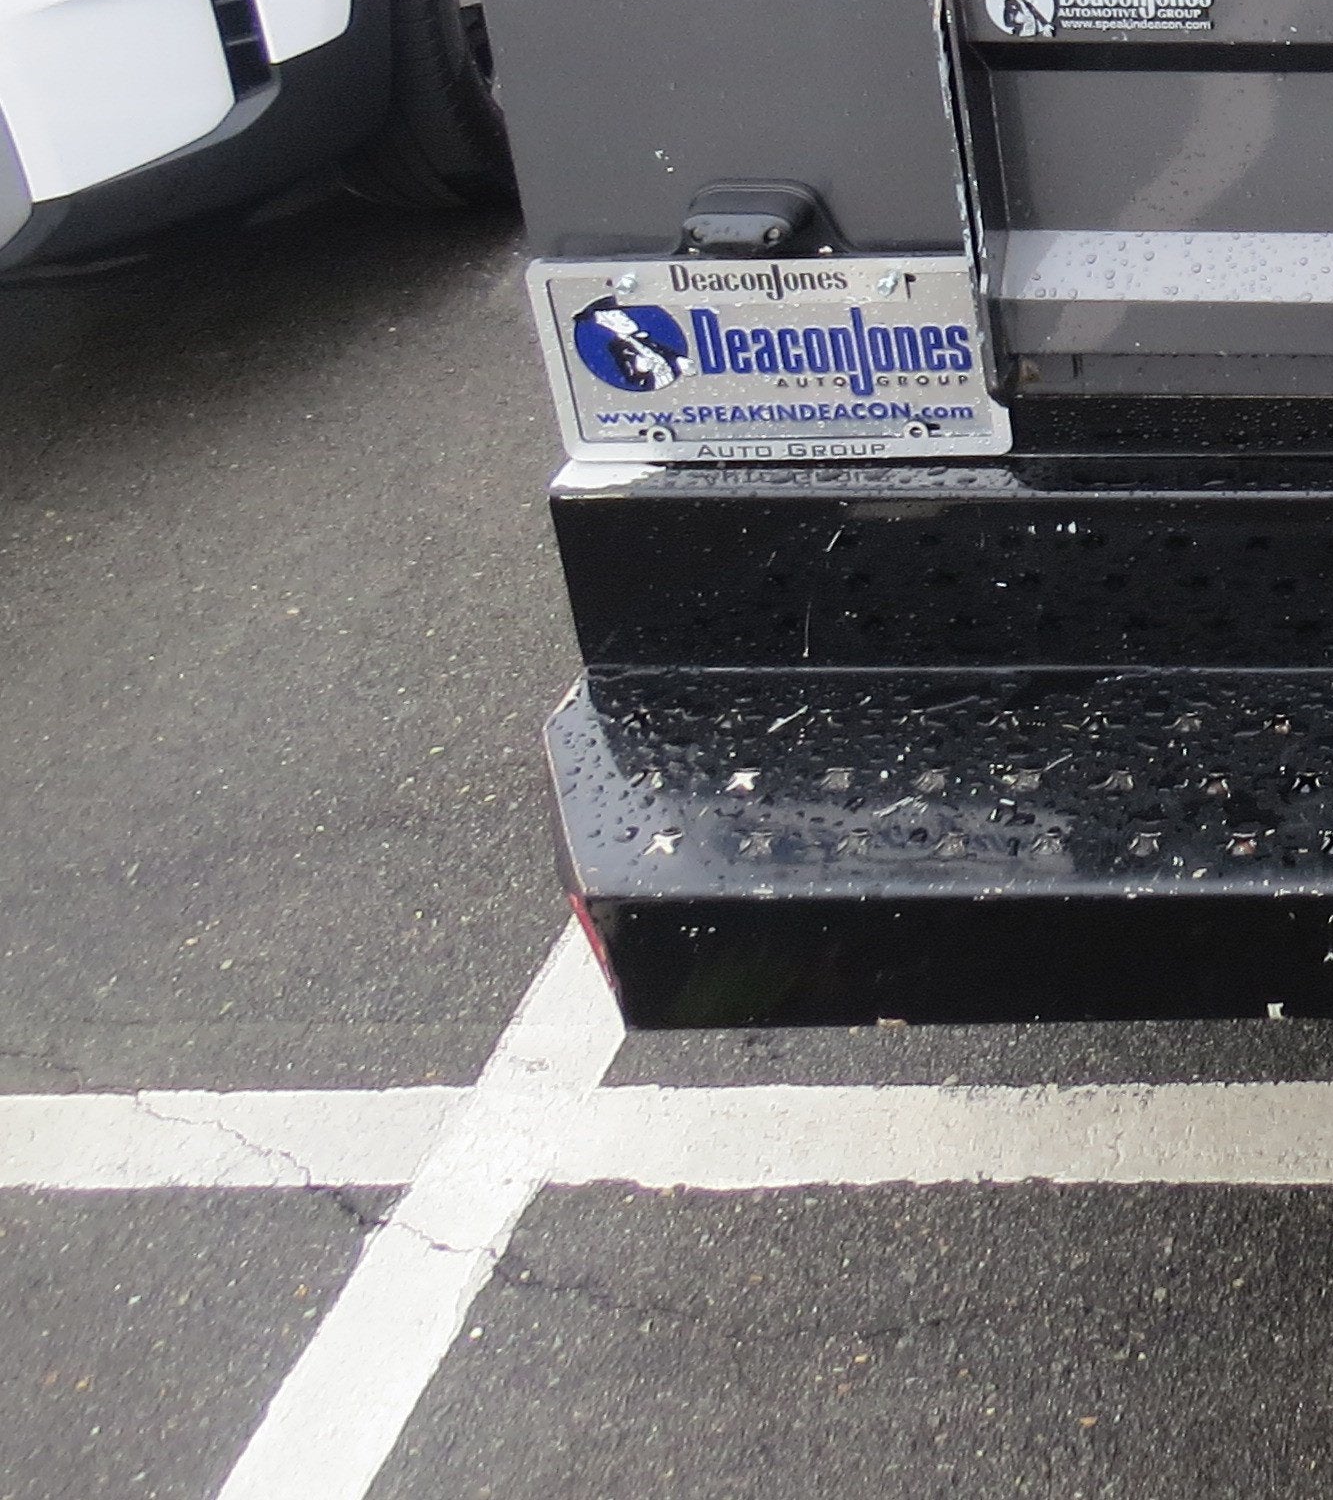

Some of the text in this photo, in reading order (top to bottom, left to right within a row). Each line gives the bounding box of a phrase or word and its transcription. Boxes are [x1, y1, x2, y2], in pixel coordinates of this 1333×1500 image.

[1058, 8, 1202, 19] AUTOMOTIVE GROUP
[1061, 19, 1212, 31] www.speakindeacon.com
[668, 264, 849, 301] DeaconJones
[690, 307, 972, 396] DeaconJones
[777, 375, 969, 388] AUTO GROUP
[595, 402, 974, 425] www.SPEAKINDEACON.com
